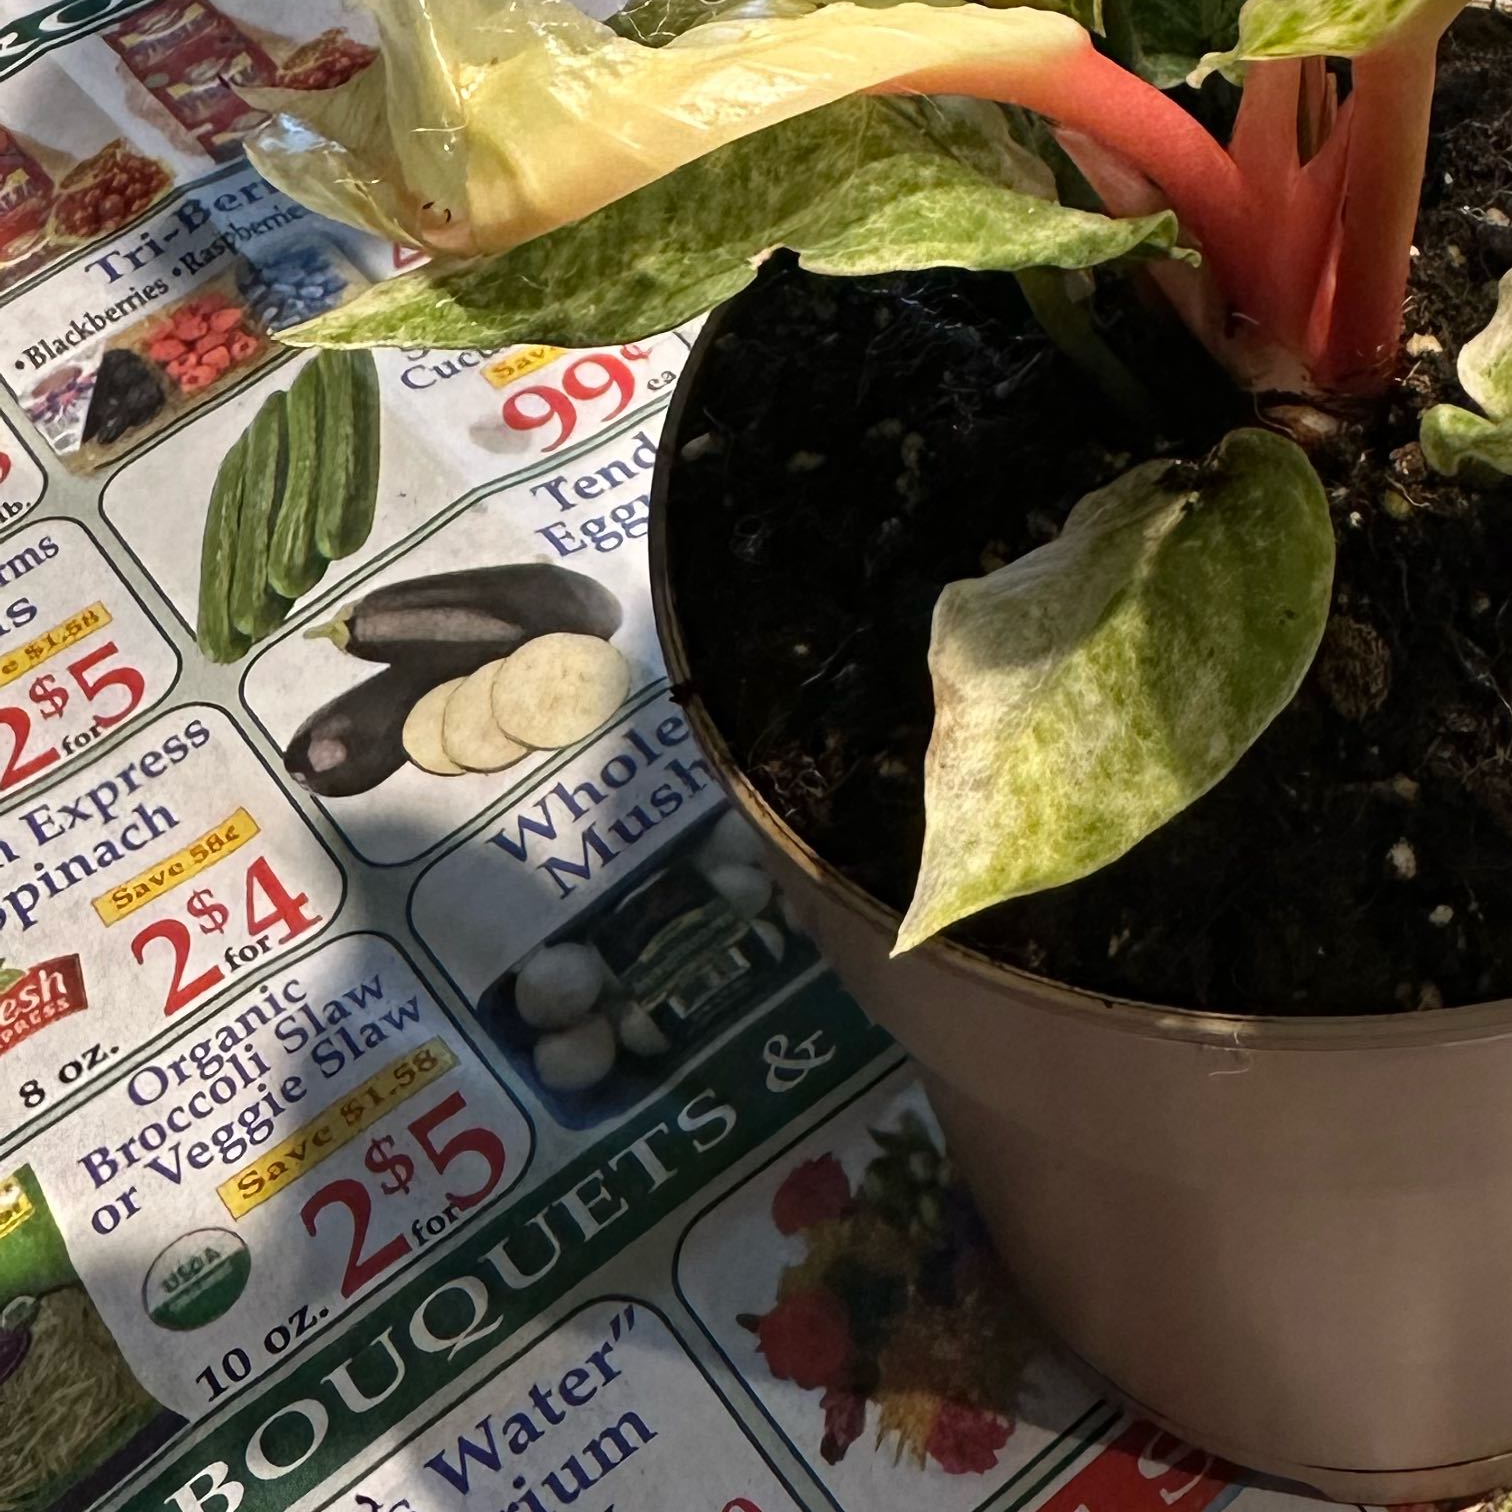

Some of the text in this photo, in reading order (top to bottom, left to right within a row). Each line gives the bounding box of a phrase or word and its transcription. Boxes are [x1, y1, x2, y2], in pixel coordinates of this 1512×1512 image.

[23, 274, 170, 372] Blackberries
[489, 347, 548, 381] Sav
[530, 431, 658, 513] Tend
[18, 718, 211, 847] Express
[60, 723, 104, 756] for
[485, 715, 690, 863] Whole
[0, 803, 182, 932] pinach
[535, 755, 716, 902] Mush
[111, 862, 185, 911] Save
[224, 934, 273, 973] for
[19, 1042, 120, 1109] 8 oz.
[77, 973, 386, 1190] Broccoli Slaw
[127, 976, 308, 1108] Organic
[90, 995, 423, 1236] or Veggie Slaw
[237, 1049, 439, 1201] Save $1.58
[163, 1029, 837, 1512] BOUQUETS &
[410, 1202, 463, 1247] for
[195, 1303, 331, 1405] 10 oz.
